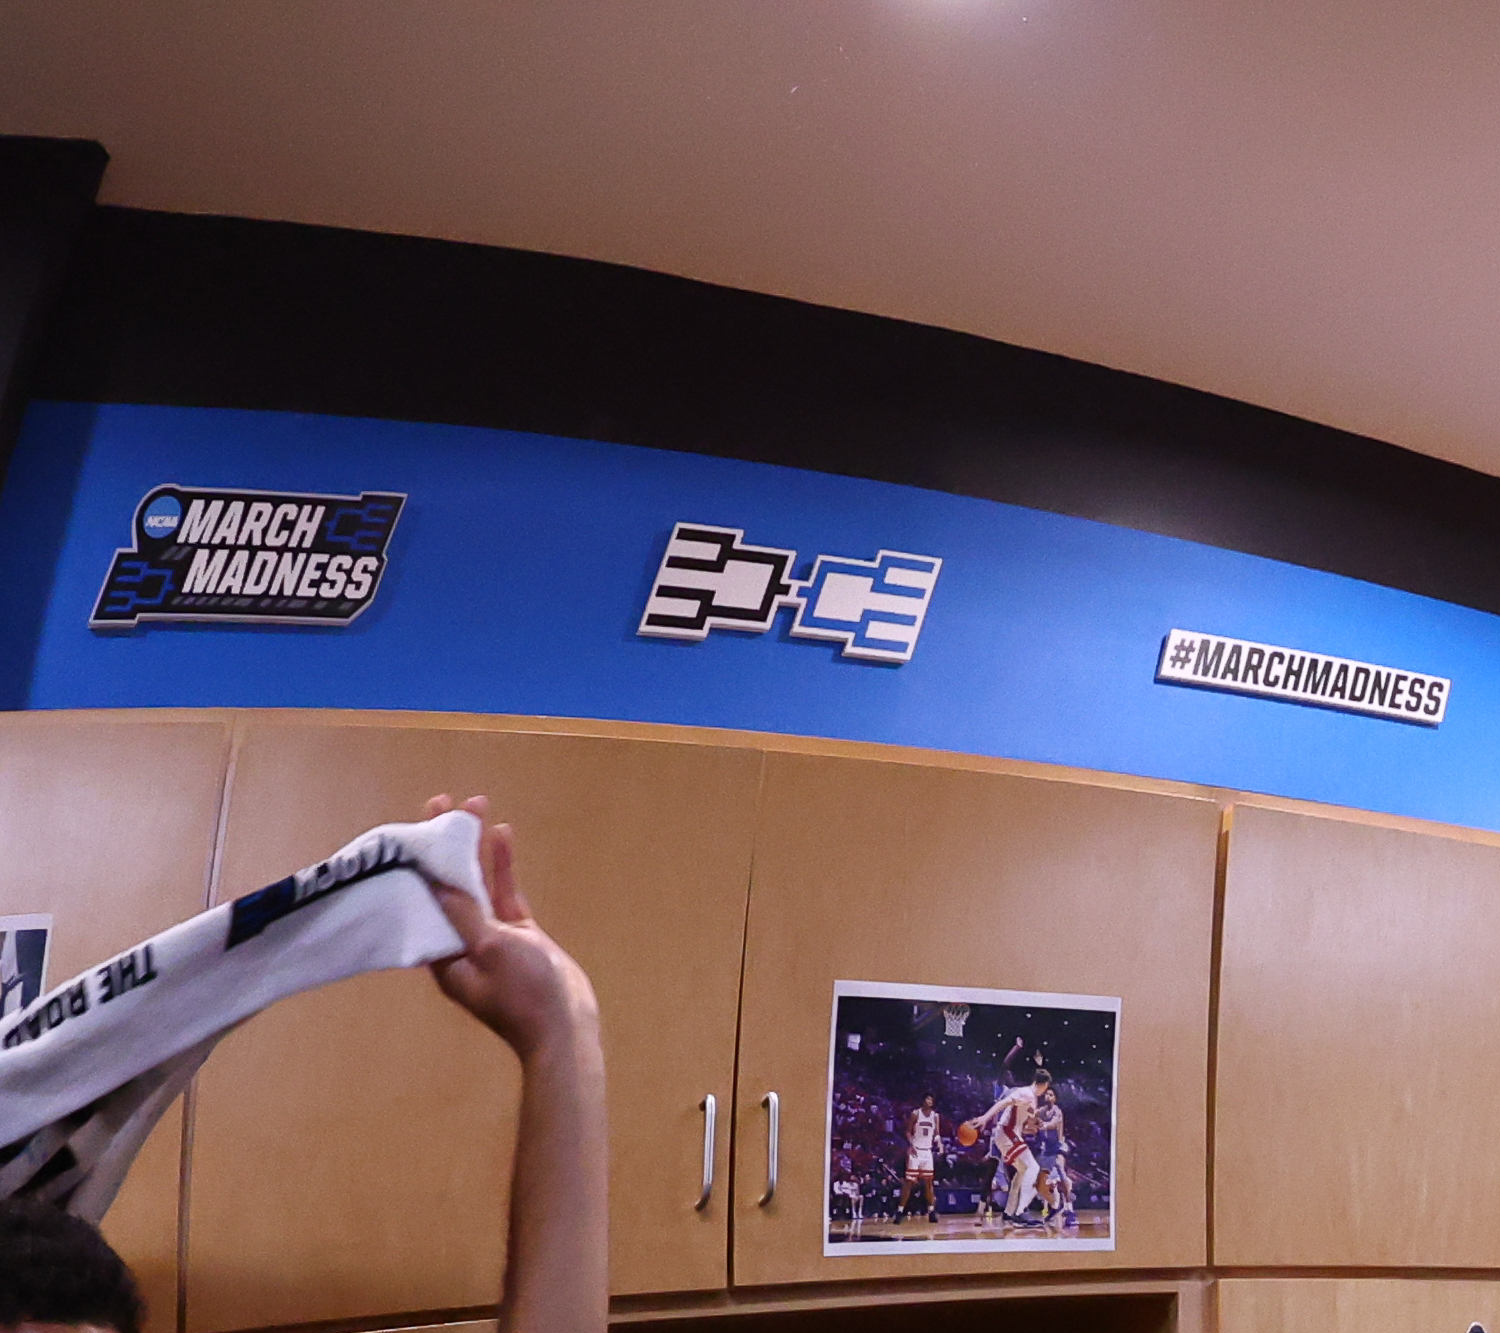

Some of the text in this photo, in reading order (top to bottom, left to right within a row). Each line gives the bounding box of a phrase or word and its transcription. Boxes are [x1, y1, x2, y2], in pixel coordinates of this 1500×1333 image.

[176, 498, 326, 549] MARCH
[182, 548, 378, 601] MADNESS
[1168, 636, 1445, 717] #MARCHMADNESS
[98, 944, 158, 1004] THE
